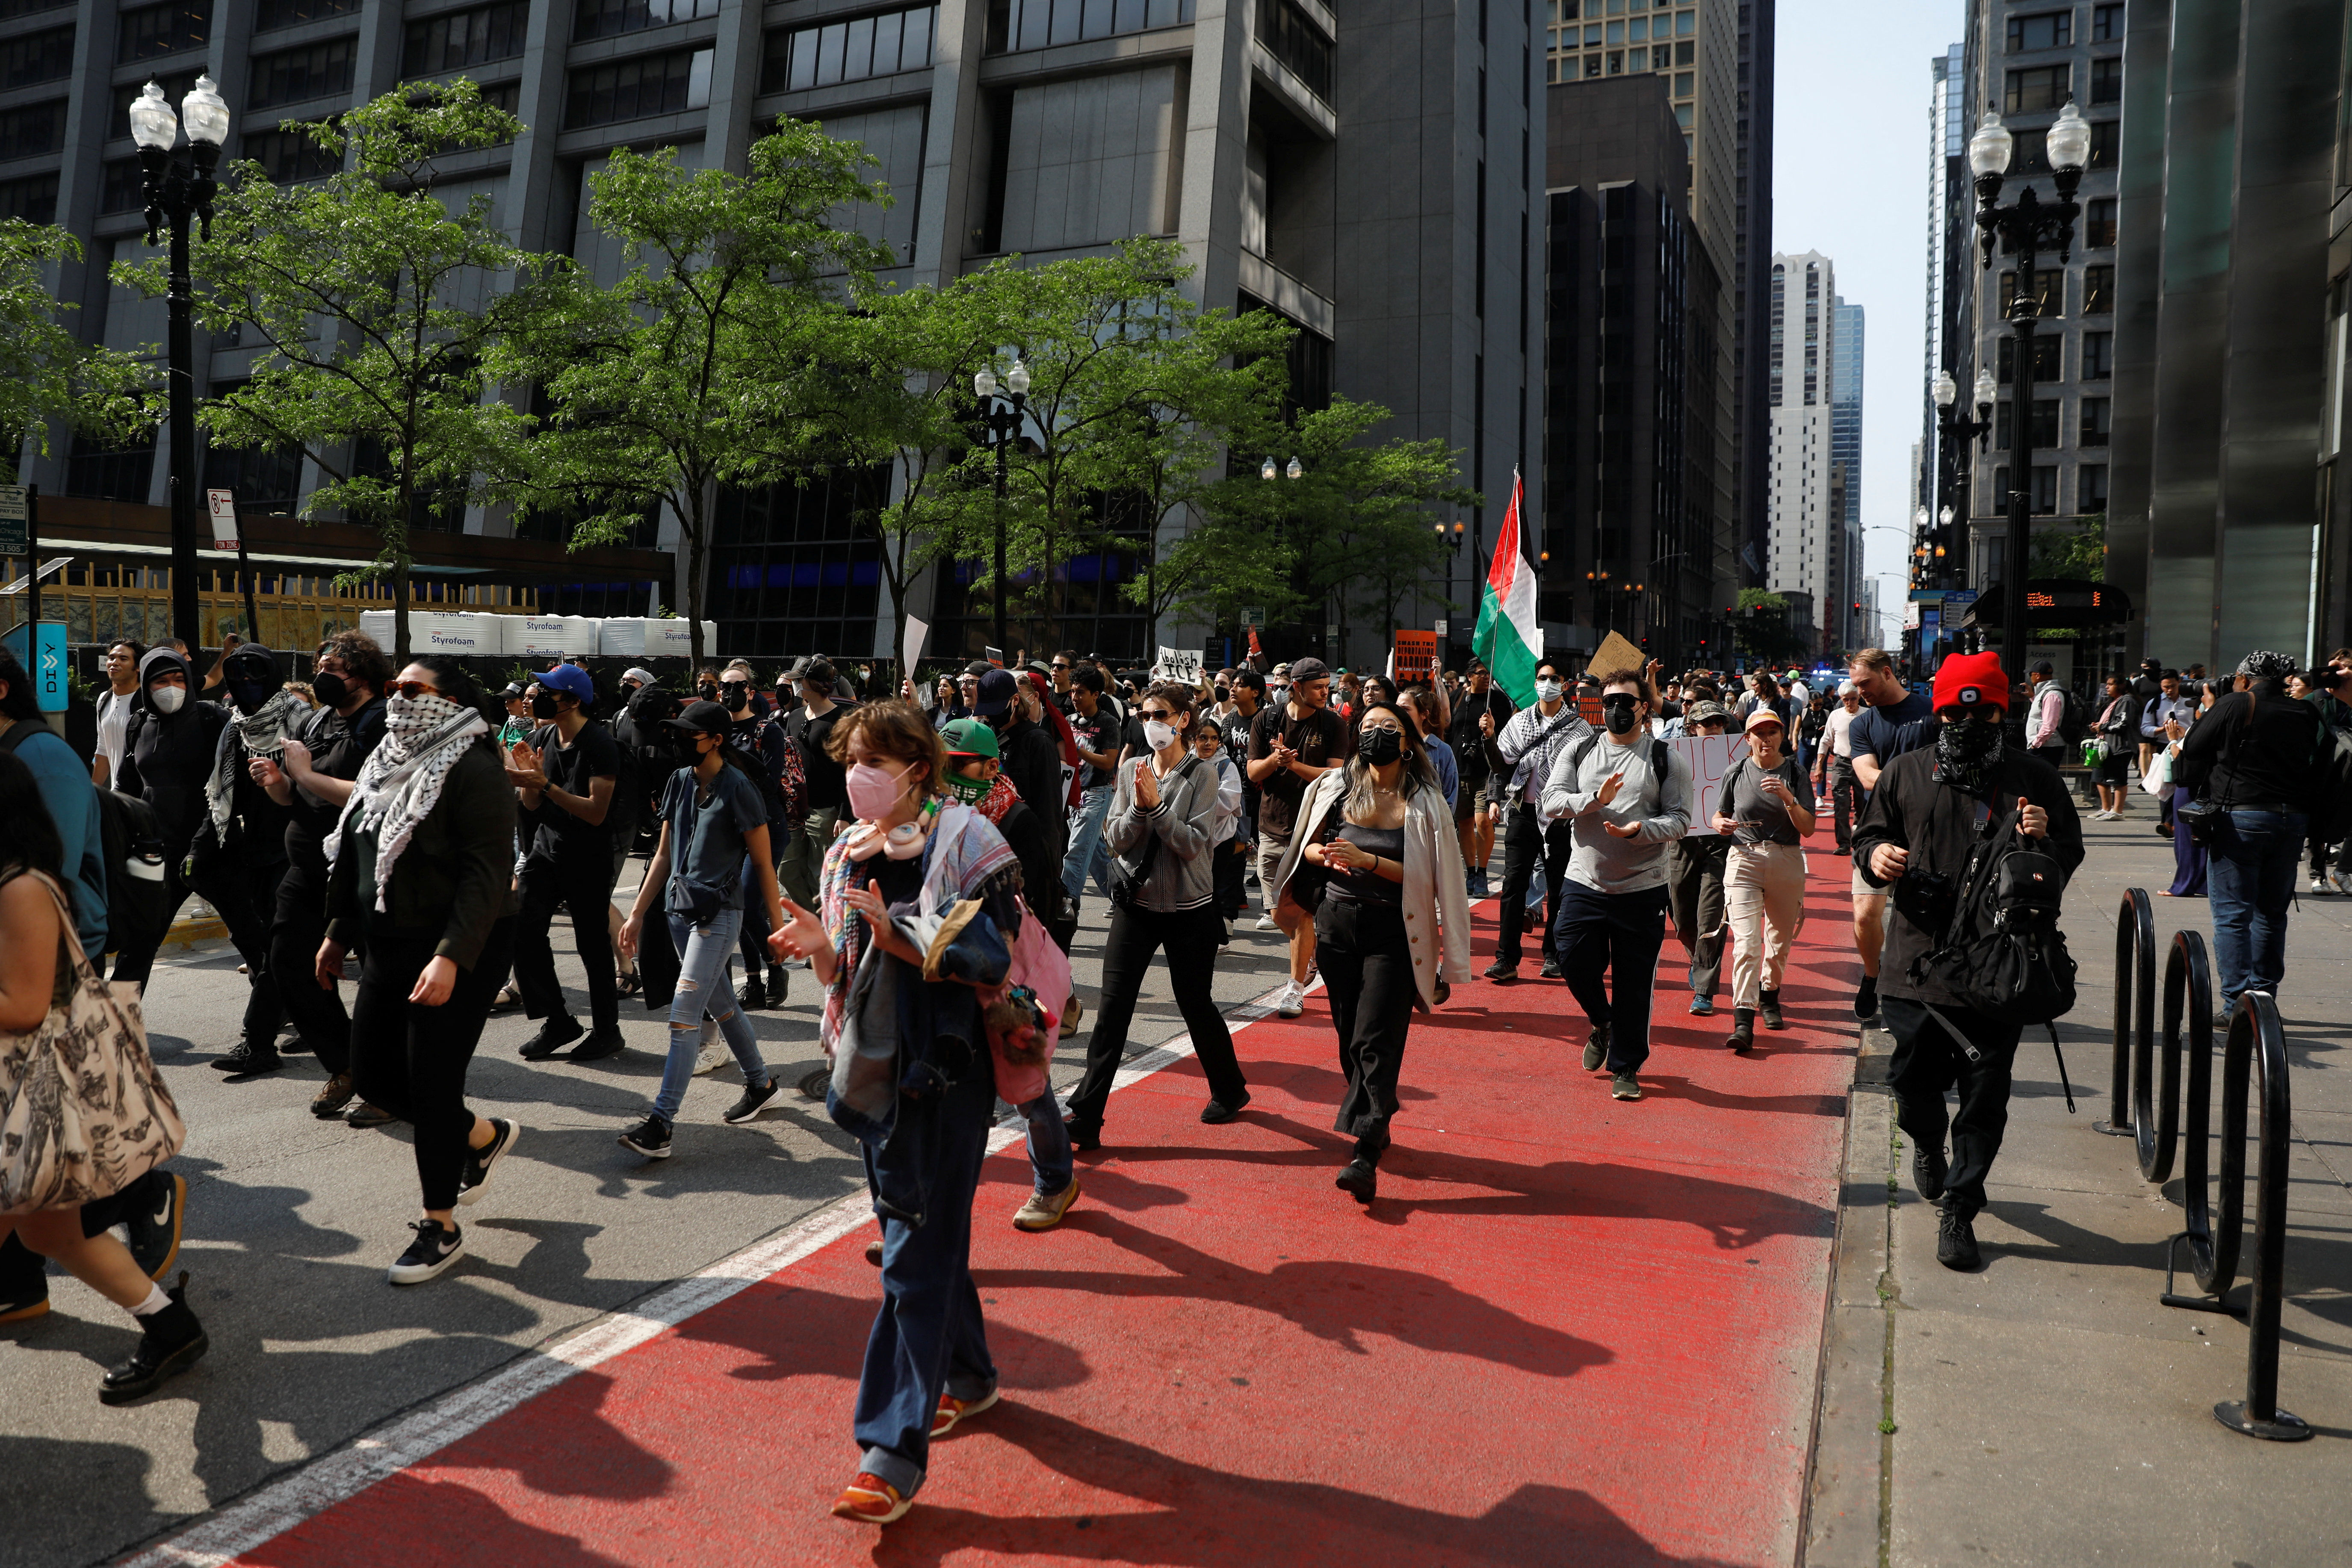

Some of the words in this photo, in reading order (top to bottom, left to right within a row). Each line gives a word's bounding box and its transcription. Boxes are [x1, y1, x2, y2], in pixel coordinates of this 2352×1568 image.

[226, 540, 238, 549] ZONE
[526, 621, 563, 631] Styrofoam
[431, 635, 475, 646] Styrofoam
[665, 632, 691, 641] Styrofoa
[1158, 647, 1197, 666] Abolish
[1398, 647, 1434, 655] DEPORTATION
[1608, 641, 1637, 667] ABOLISH
[1164, 664, 1196, 683] ICE
[1676, 735, 1745, 781] UCK
[963, 787, 977, 799] IS
